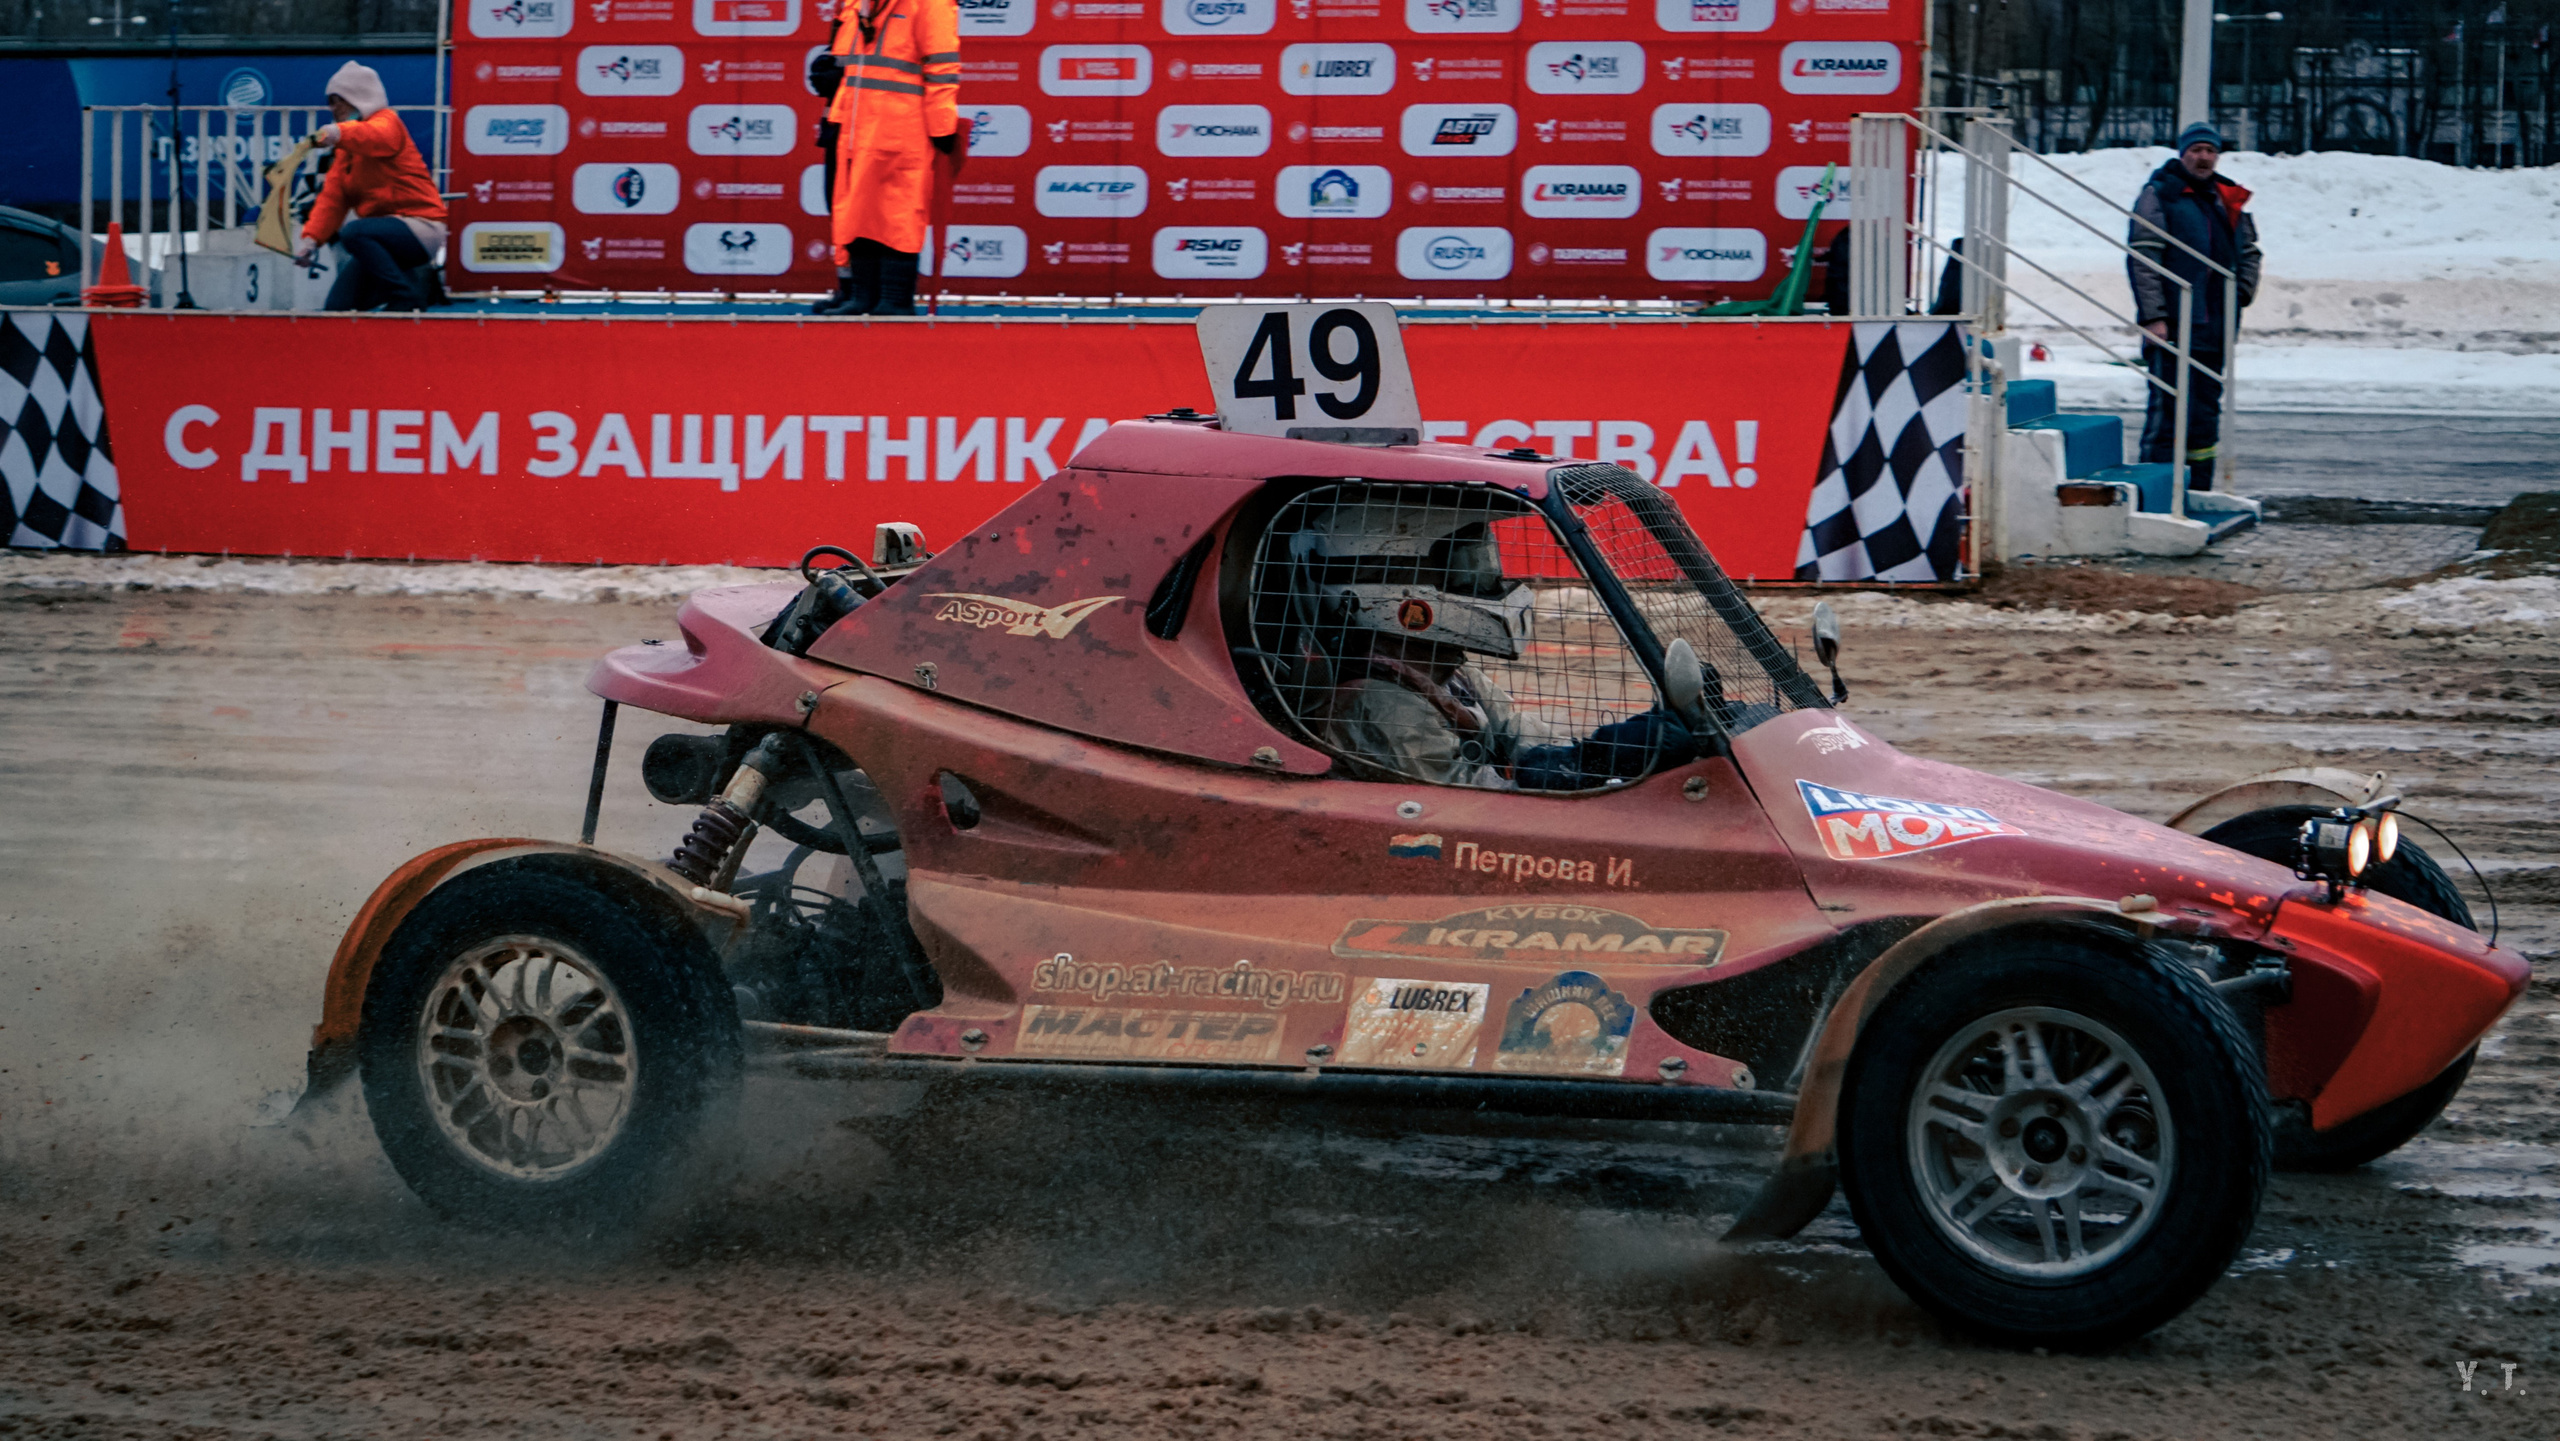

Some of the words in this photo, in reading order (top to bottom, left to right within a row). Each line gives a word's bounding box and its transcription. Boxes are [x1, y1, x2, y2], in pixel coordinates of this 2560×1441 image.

[1193, 2, 1247, 15] RUSTA
[1315, 60, 1374, 77] LUBREX
[1811, 59, 1888, 70] KRAMAR
[1193, 125, 1261, 136] YOKOHAMA
[1440, 120, 1493, 133] АВТО
[1047, 182, 1136, 193] МАСТЕР
[1552, 184, 1627, 195] KRAMAR
[1185, 239, 1243, 251] RSMG
[1432, 247, 1486, 259] RUSTA
[1682, 249, 1753, 261] YOKOHAMA
[246, 263, 259, 303] 3
[1234, 309, 1381, 420] 49
[164, 404, 220, 469] С
[241, 407, 500, 483] ДНЕМ
[935, 600, 1047, 627] ASport
[1807, 785, 1995, 823] LIQUI
[1827, 812, 2004, 856] MOLY
[1455, 841, 1598, 883] Петрова
[1606, 857, 1640, 887] И.
[1486, 906, 1610, 925] КУБОК
[1426, 928, 1716, 955] KRAMAR
[1033, 954, 1343, 1007] shop.at-racing.ru
[1389, 987, 1476, 1013] LUBREX
[1027, 1010, 1280, 1042] МАСТЕР
